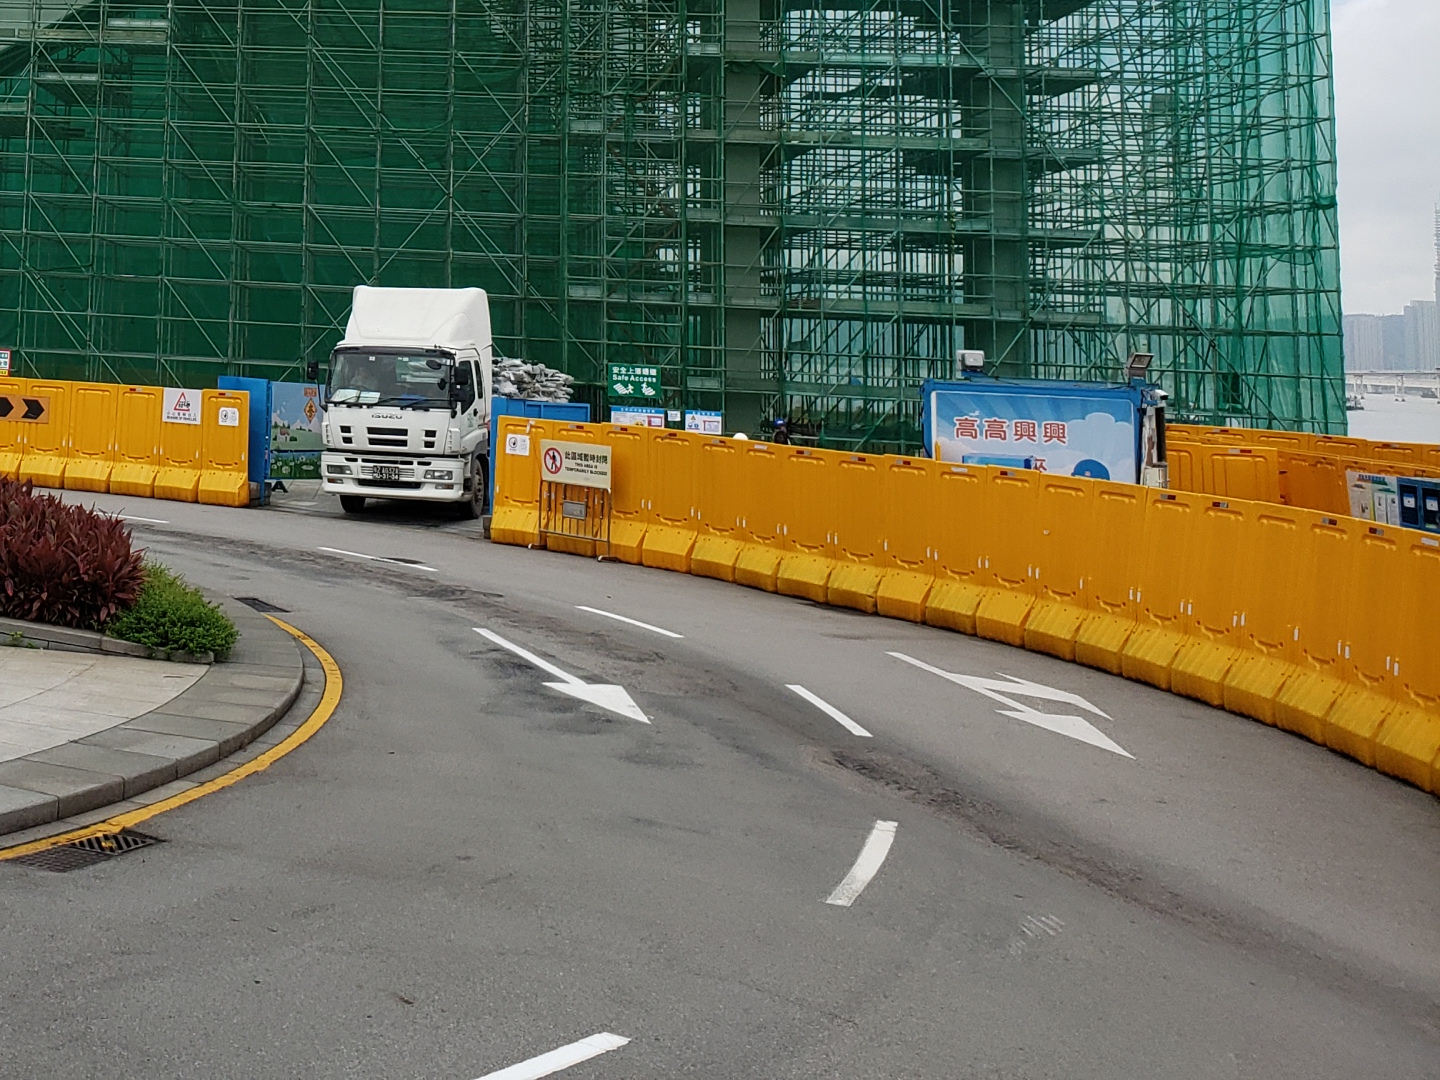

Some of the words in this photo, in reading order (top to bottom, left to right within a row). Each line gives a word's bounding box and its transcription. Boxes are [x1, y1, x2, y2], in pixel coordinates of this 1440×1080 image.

[630, 375, 657, 383] Access
[955, 417, 1068, 444] 高高興興
